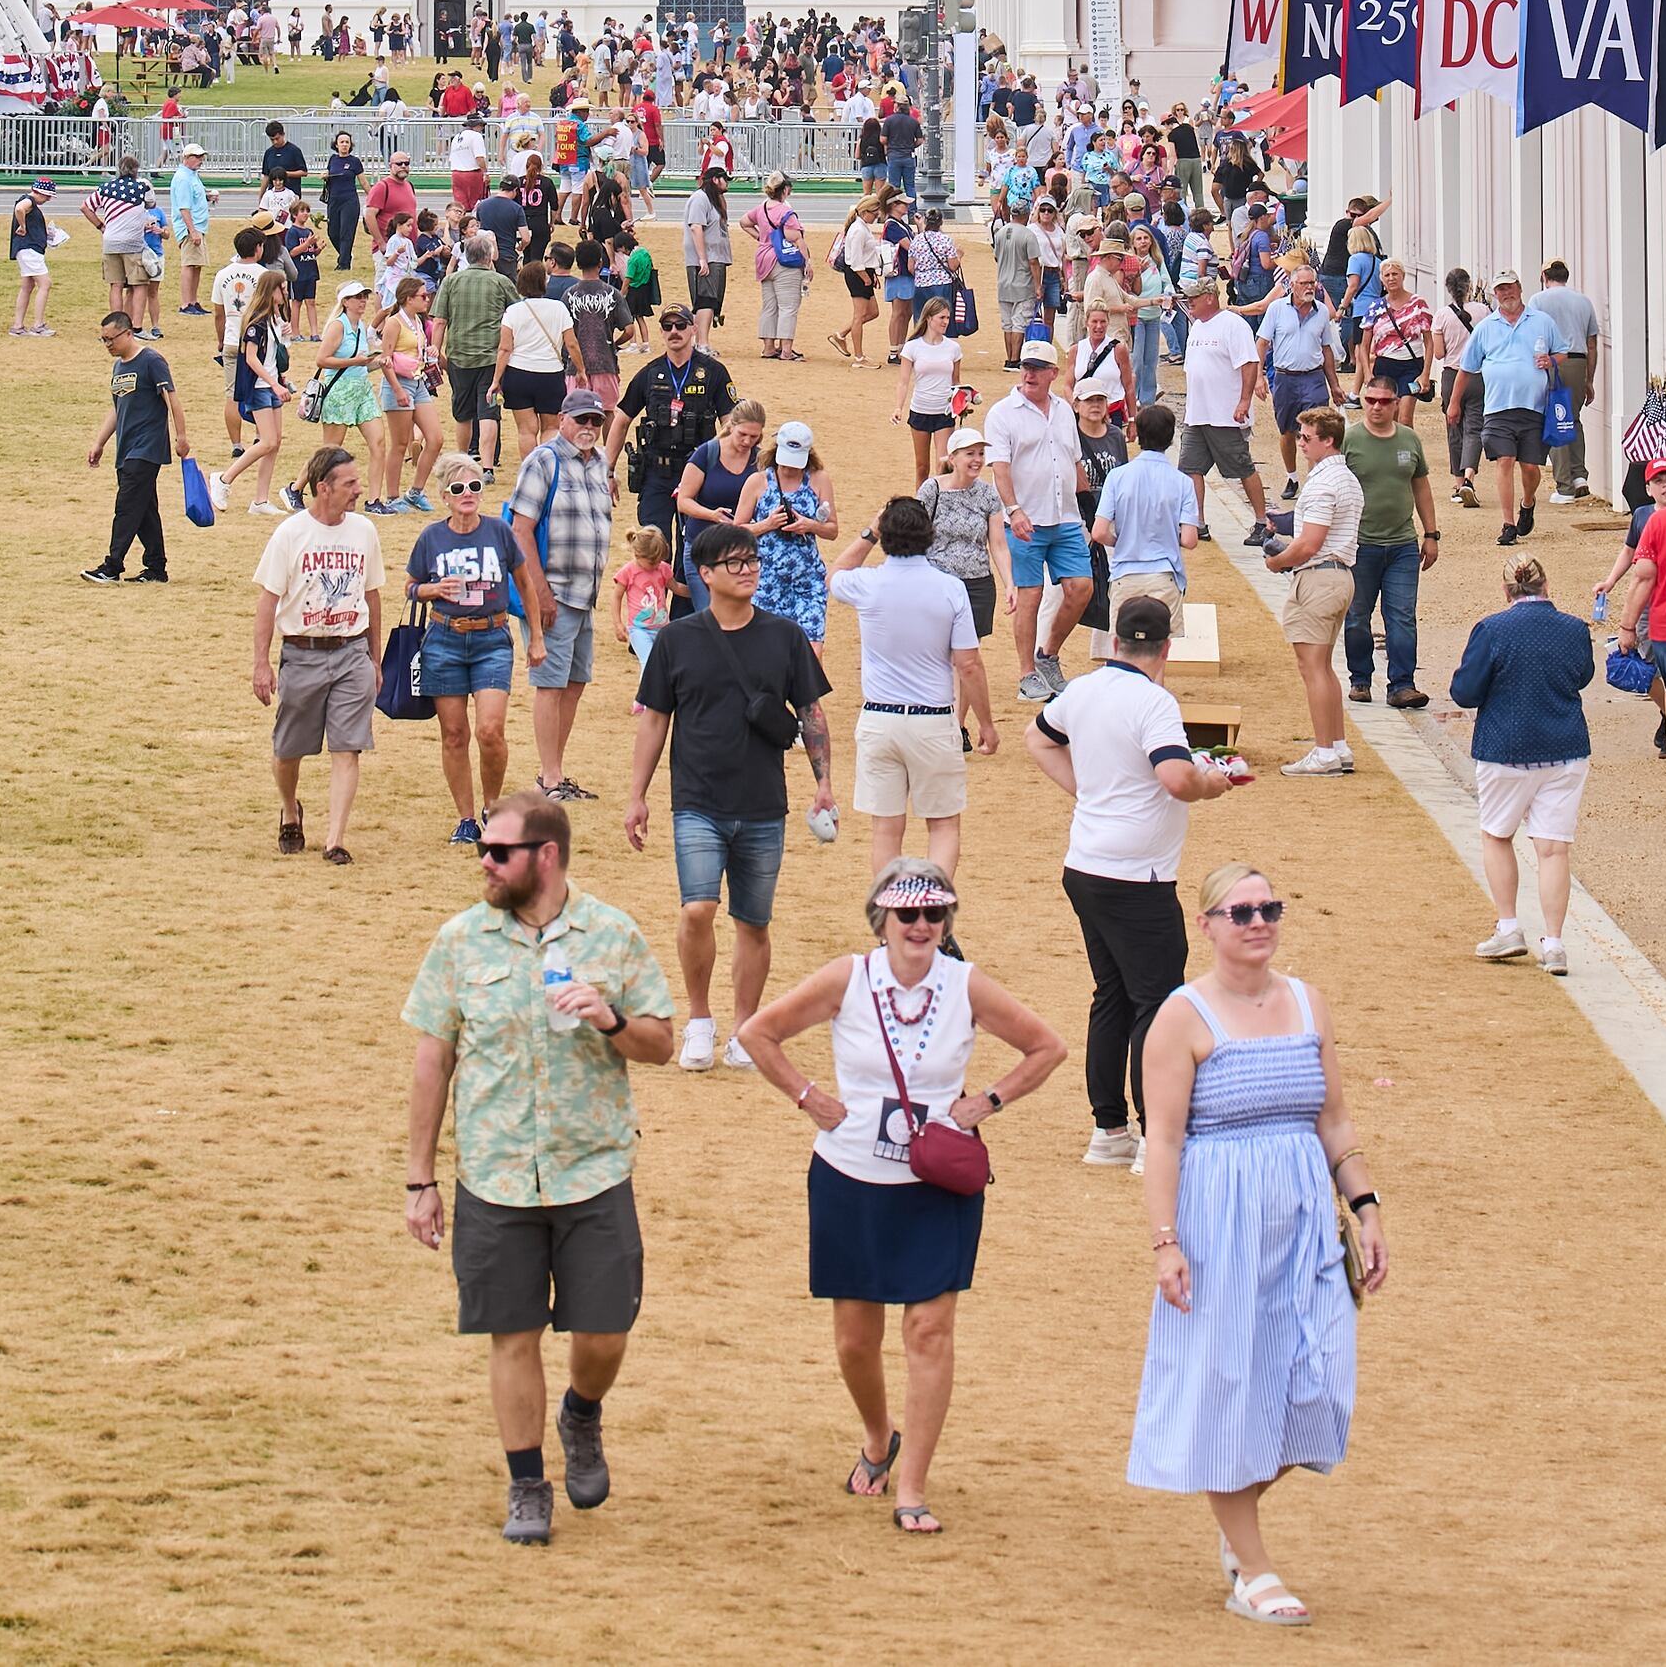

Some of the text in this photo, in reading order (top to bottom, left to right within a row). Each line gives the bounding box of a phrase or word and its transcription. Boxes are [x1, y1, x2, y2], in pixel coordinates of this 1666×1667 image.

[520, 188, 543, 207] 10
[302, 552, 364, 576] AMERICA
[436, 546, 503, 583] USA
